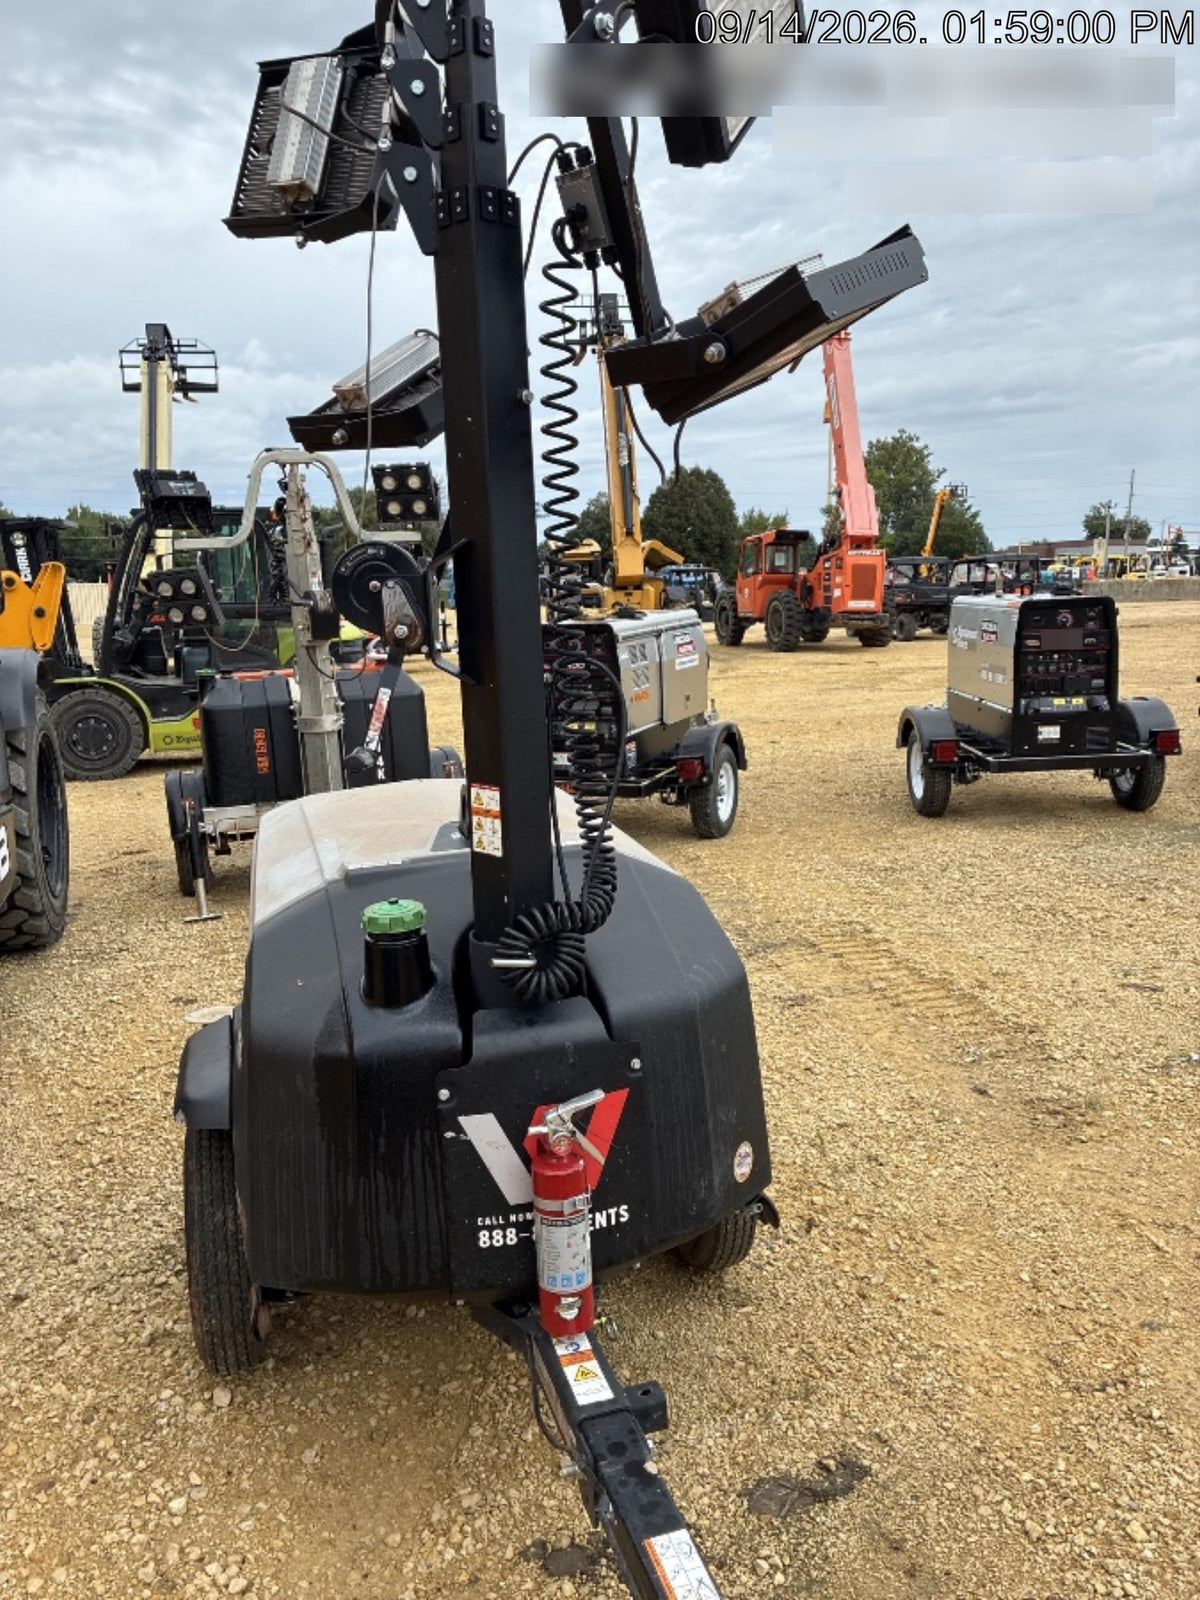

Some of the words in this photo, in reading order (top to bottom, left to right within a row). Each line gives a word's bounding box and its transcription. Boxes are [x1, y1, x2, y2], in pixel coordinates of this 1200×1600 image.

[15, 546, 33, 582] CLARK
[477, 1215, 505, 1226] CALL
[509, 1212, 535, 1223] NOW
[478, 1228, 536, 1249] 888-
